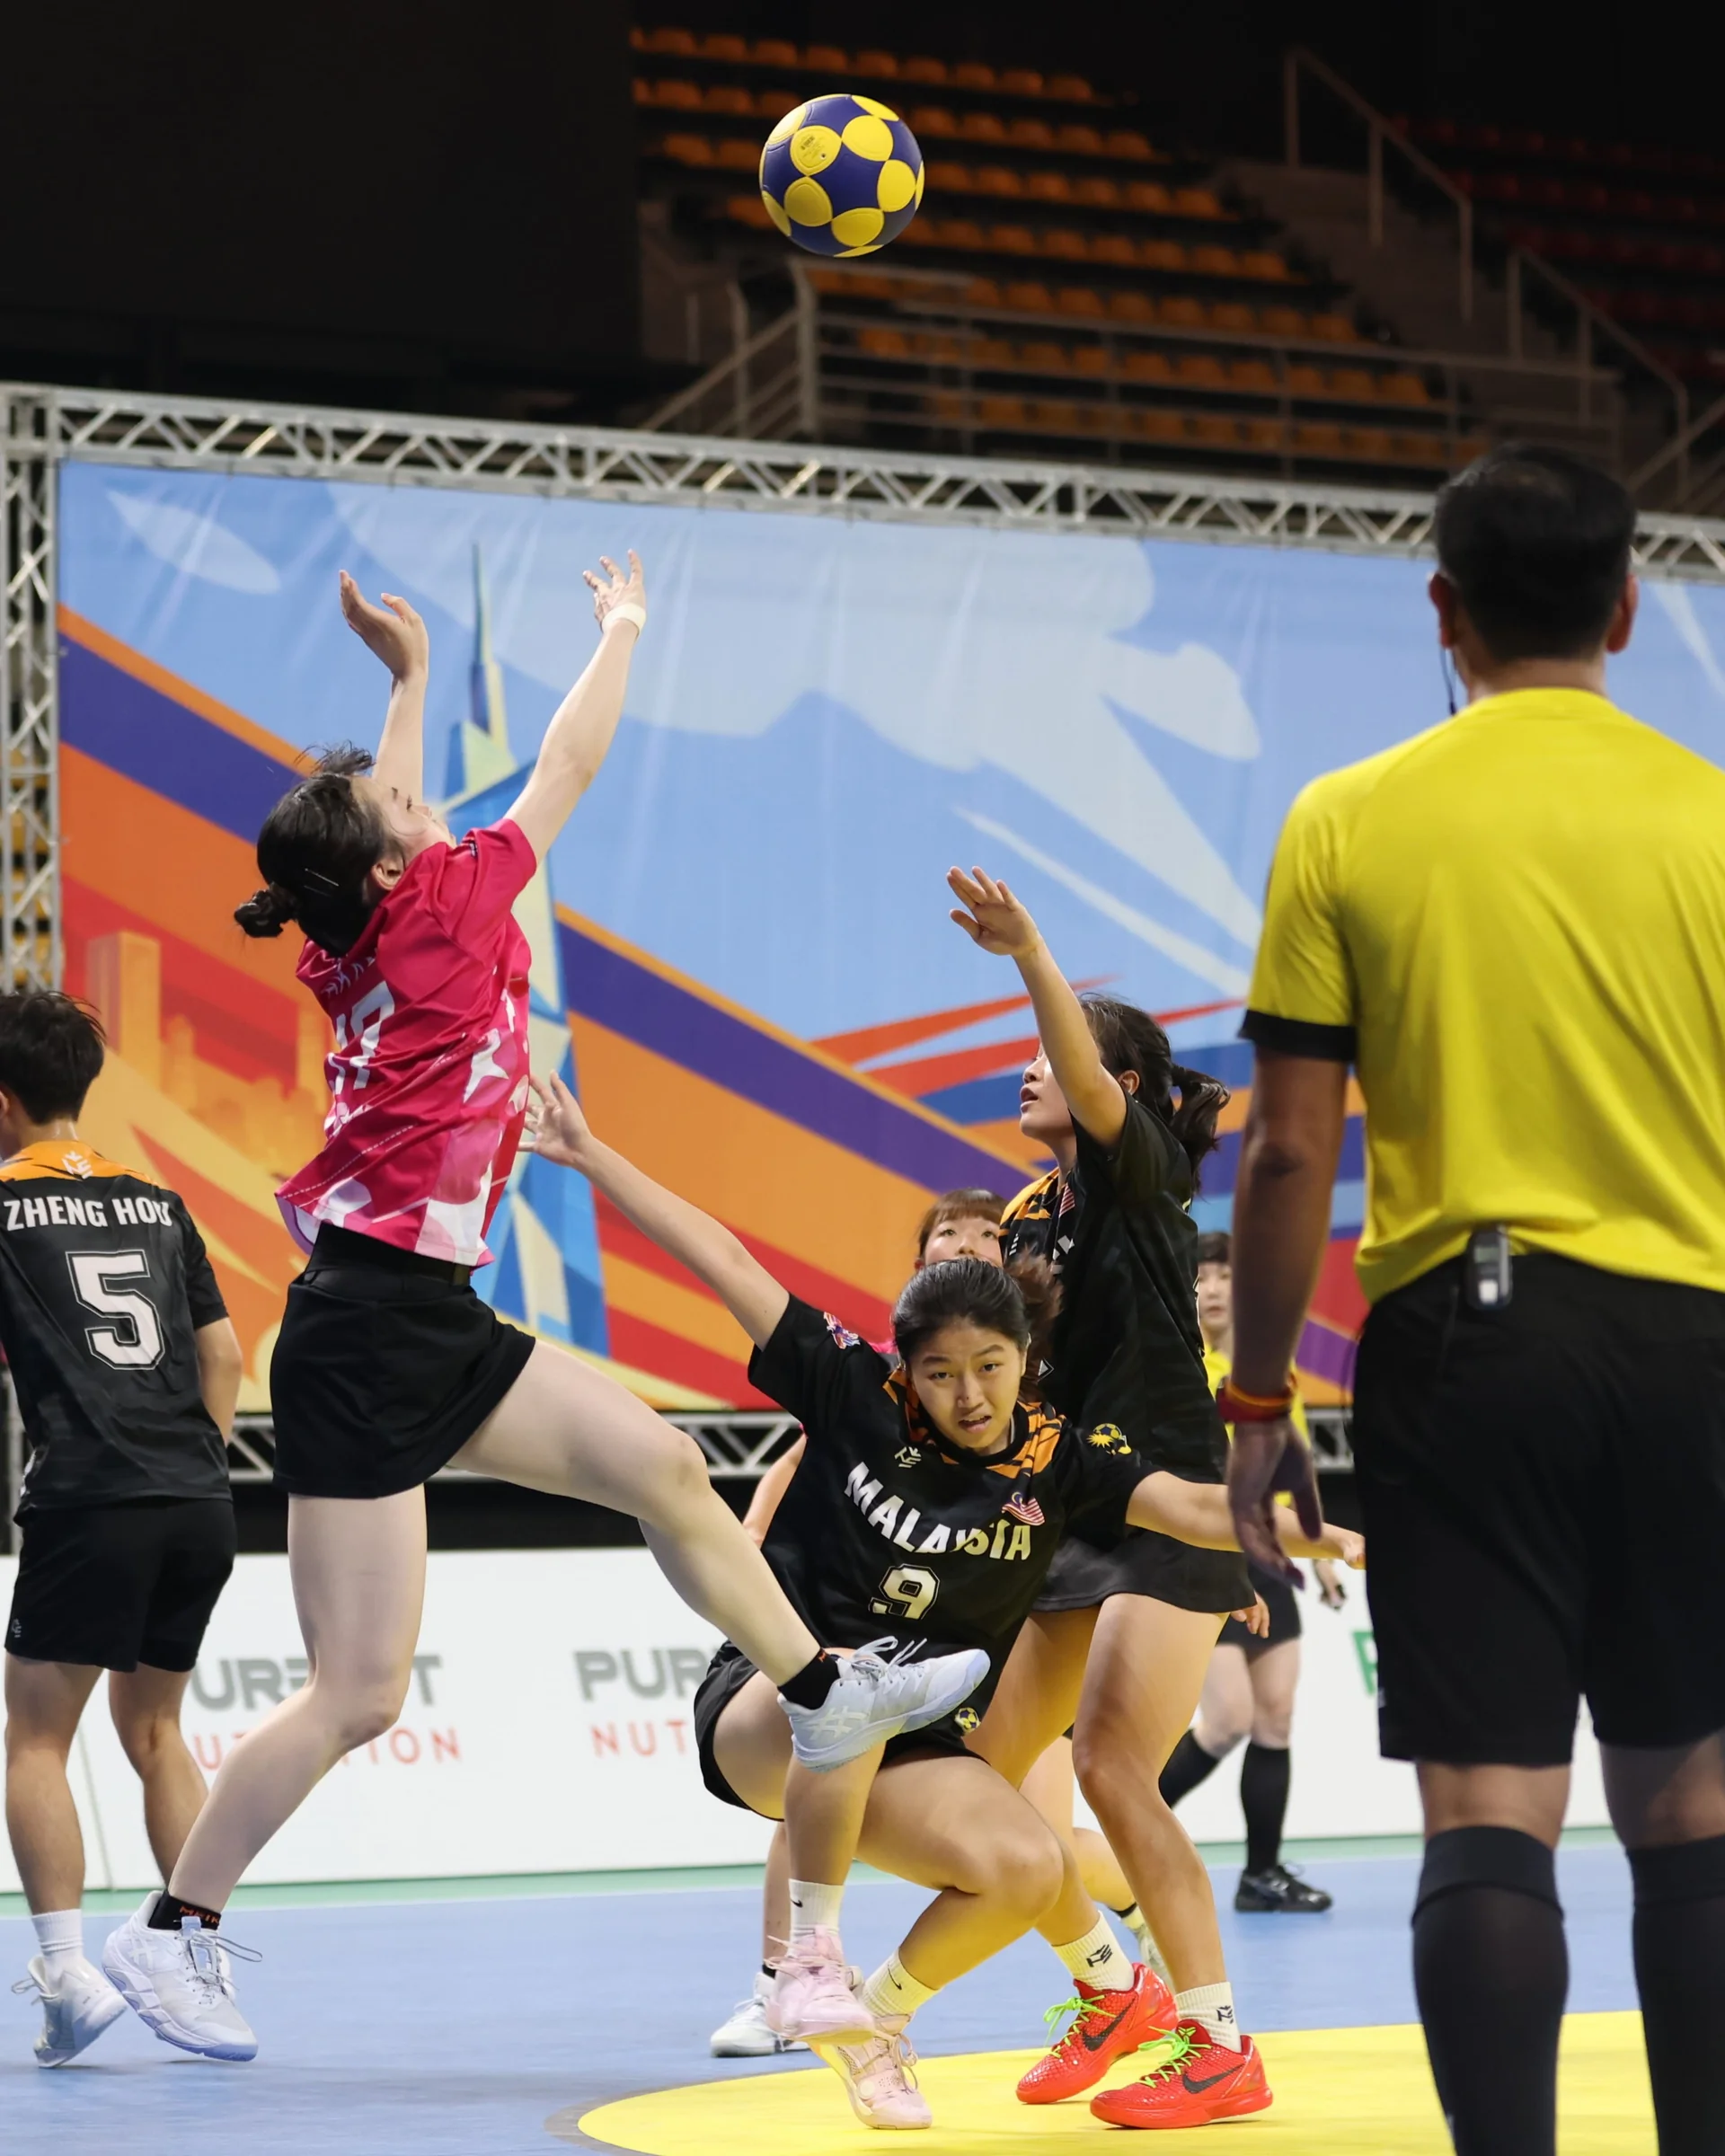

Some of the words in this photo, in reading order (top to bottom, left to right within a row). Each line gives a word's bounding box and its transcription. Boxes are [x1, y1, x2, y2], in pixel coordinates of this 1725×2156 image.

[4, 1196, 109, 1232] ZHENG
[111, 1197, 172, 1227] HOU
[66, 1250, 165, 1370] 5
[868, 1563, 941, 1620] 9
[573, 1647, 721, 1701] PUR
[589, 1719, 687, 1758] NUT
